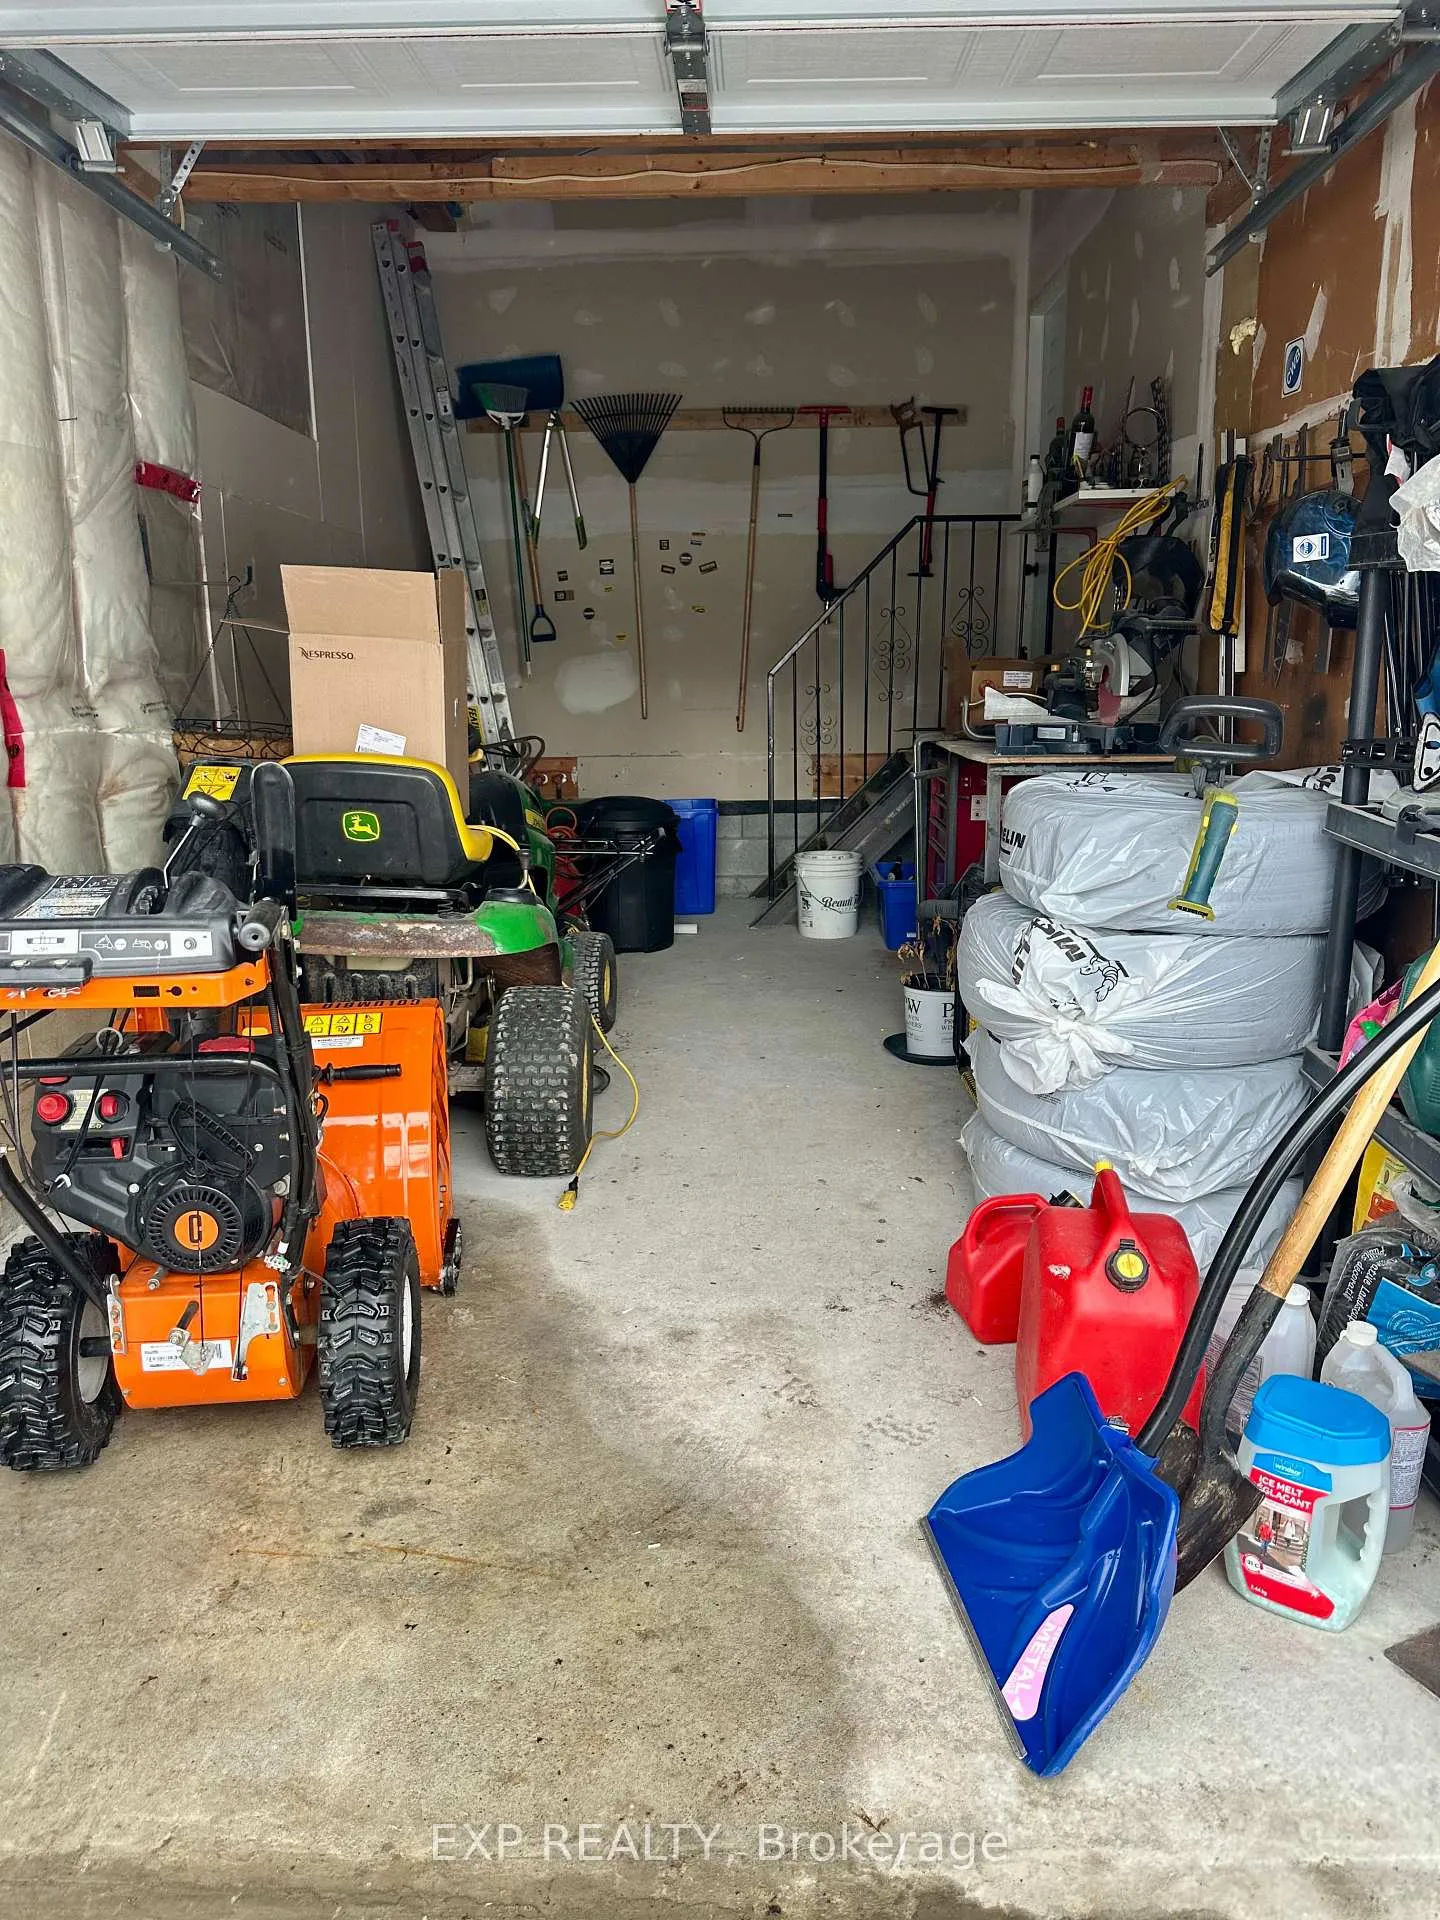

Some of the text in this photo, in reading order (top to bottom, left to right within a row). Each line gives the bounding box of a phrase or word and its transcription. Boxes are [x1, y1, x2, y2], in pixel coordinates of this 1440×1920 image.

[298, 646, 354, 660] NESPRESSO
[322, 1000, 420, 1009] COLUMBIA
[1257, 1483, 1312, 1509] ÉGLAÇANT
[1259, 1475, 1303, 1498] ICE MELT
[1014, 1621, 1055, 1695] METAL
